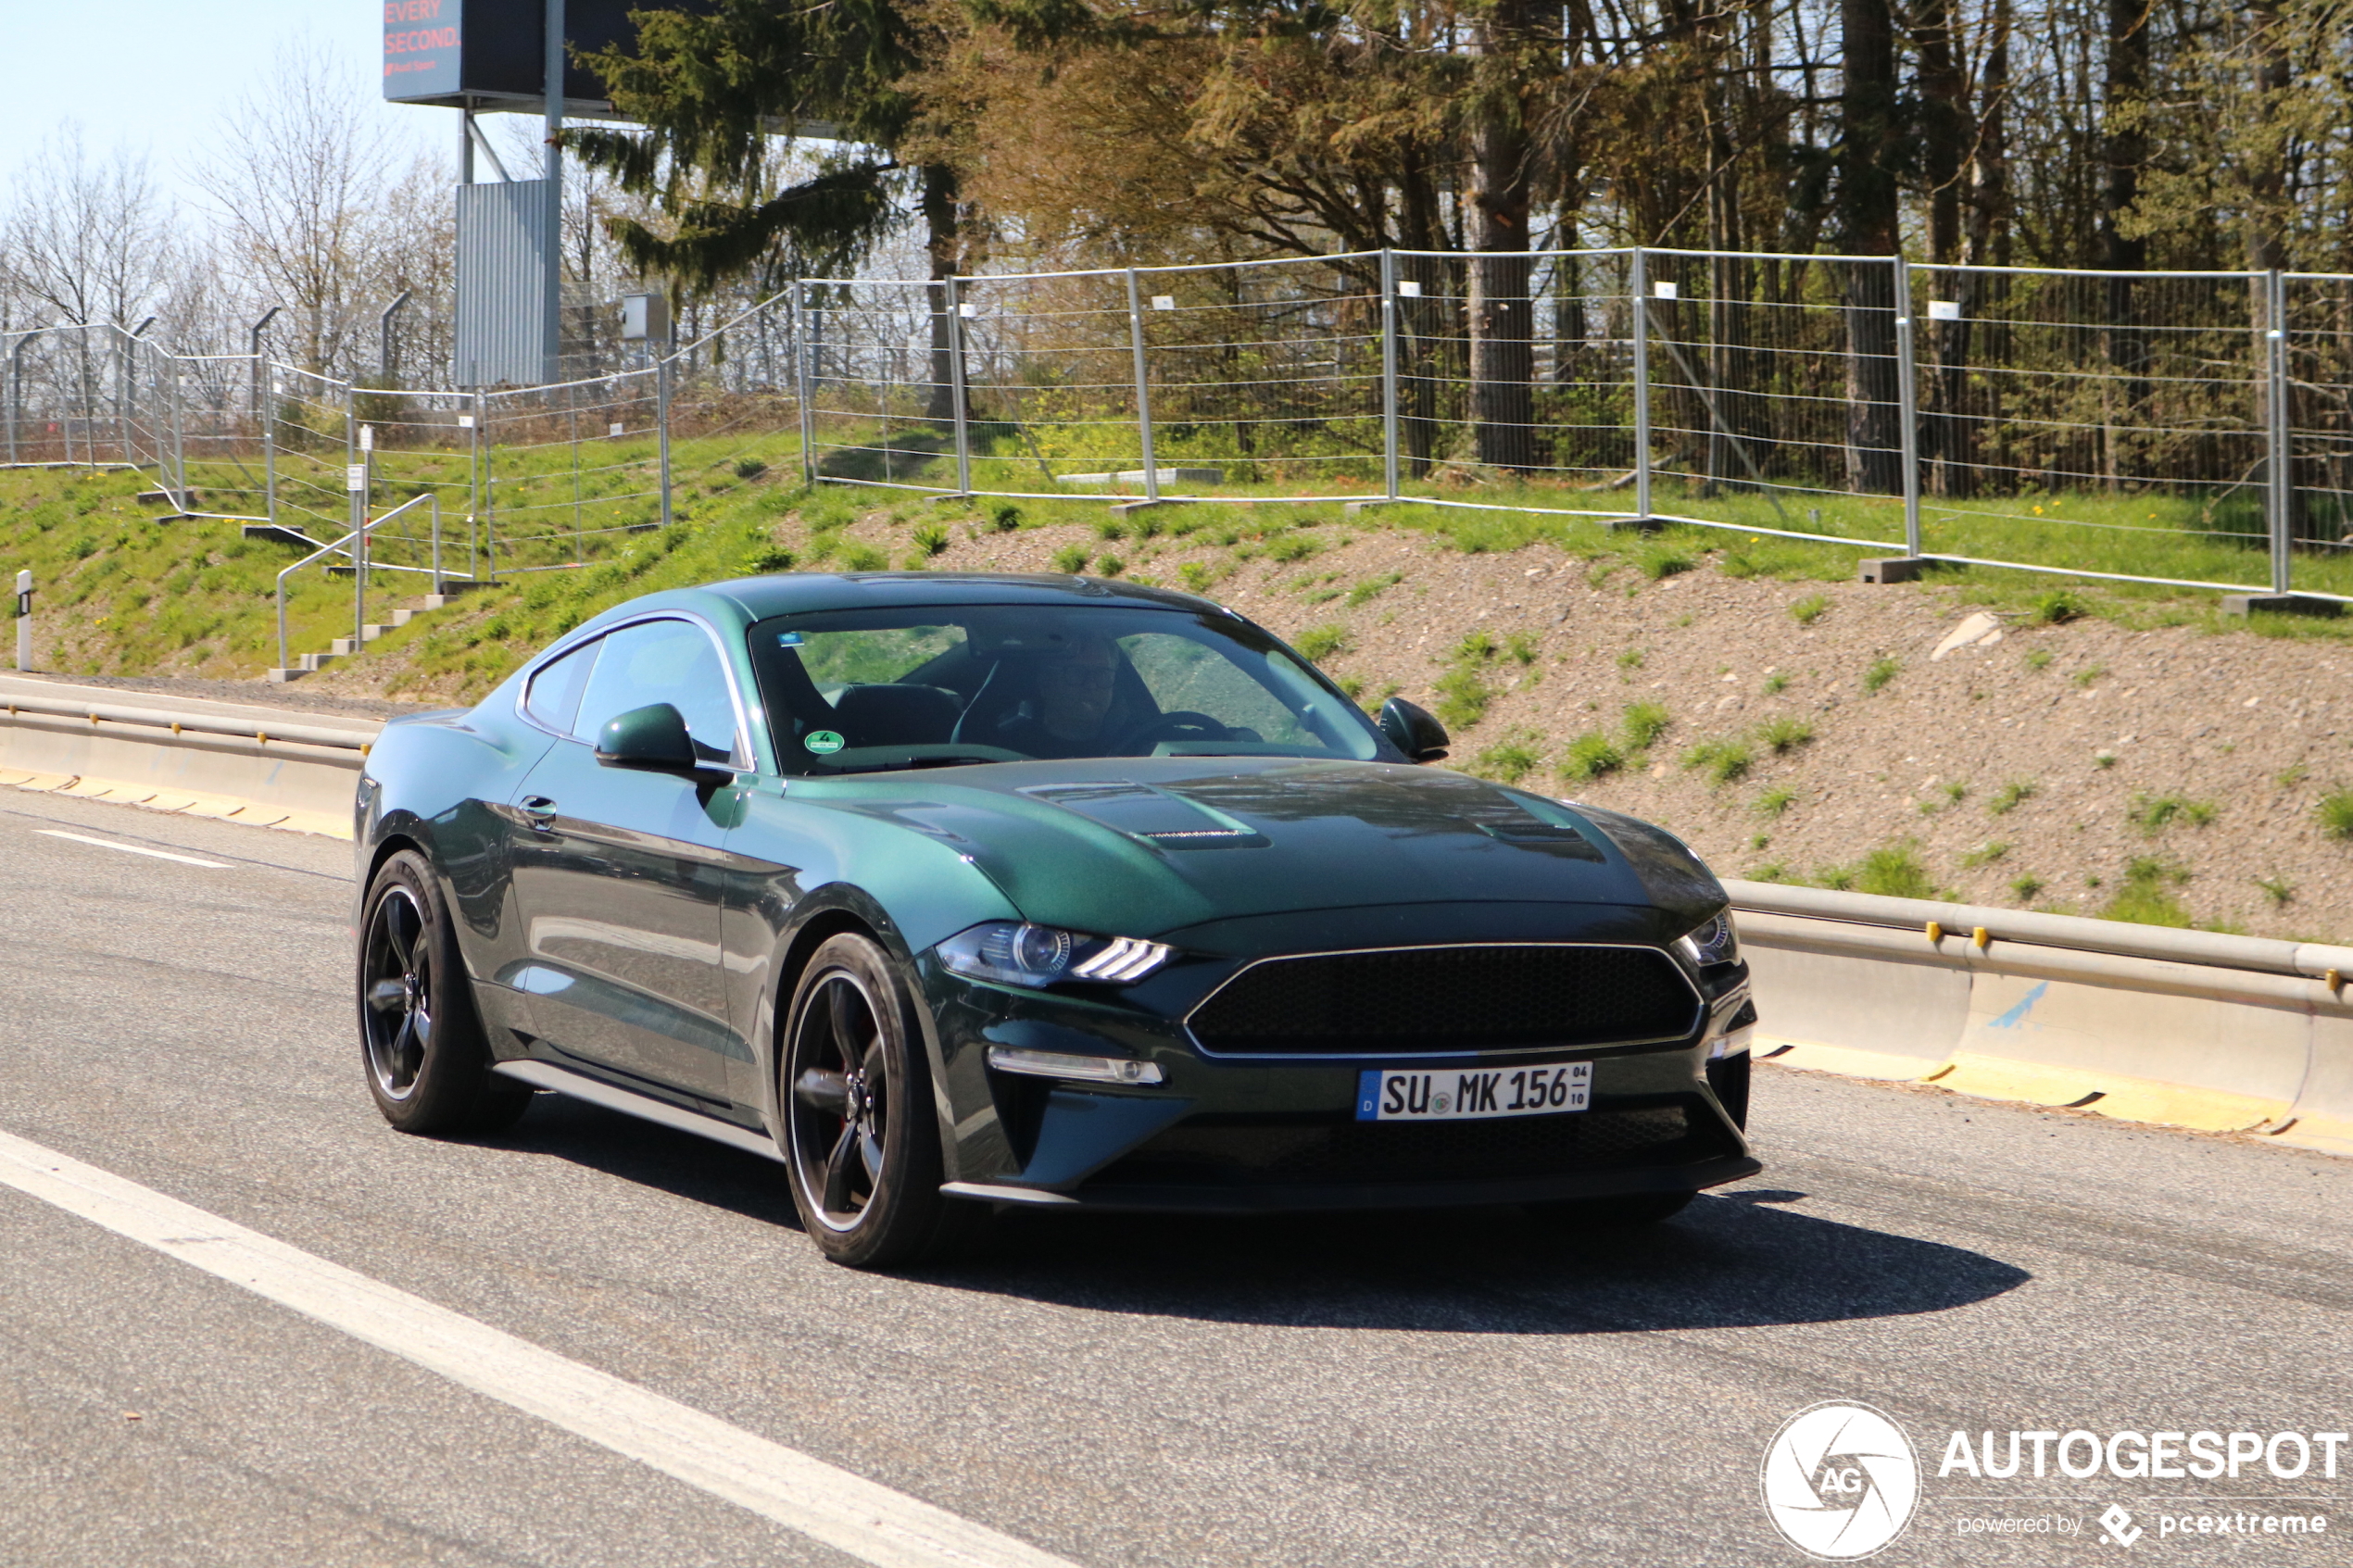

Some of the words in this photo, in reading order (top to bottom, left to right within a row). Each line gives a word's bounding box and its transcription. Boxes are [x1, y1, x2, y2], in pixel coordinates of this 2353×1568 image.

[384, 0, 441, 23] EVERY
[384, 27, 461, 54] SECOND.
[819, 732, 830, 742] 4
[1573, 1066, 1587, 1077] 04
[1363, 1100, 1373, 1111] D
[1383, 1075, 1431, 1114] SU
[1455, 1073, 1502, 1112] MK
[1506, 1068, 1567, 1110] 156
[1571, 1093, 1584, 1105] 10
